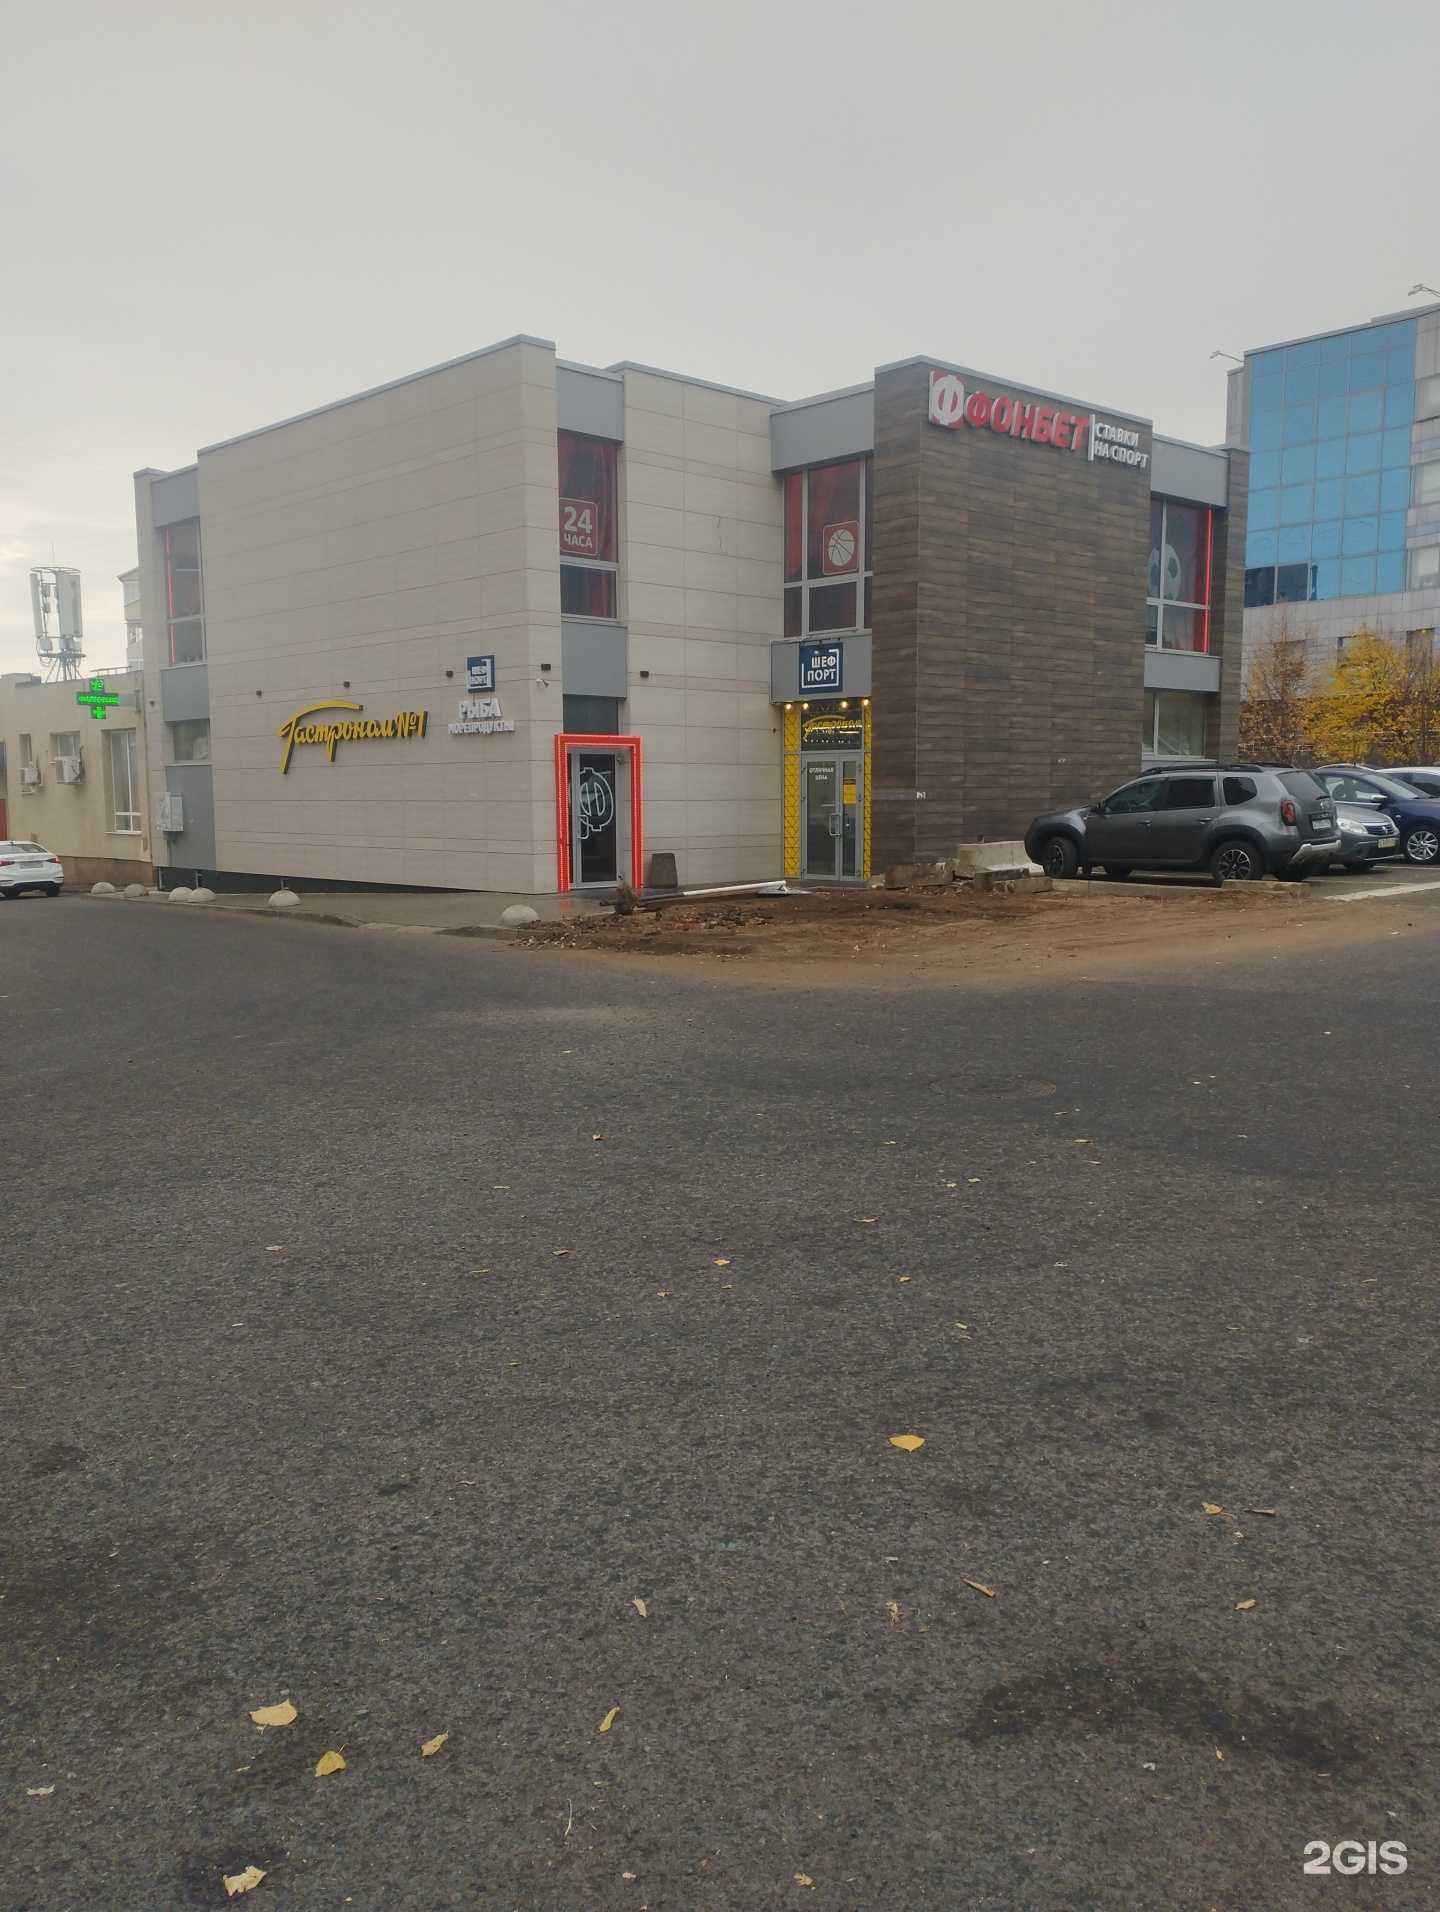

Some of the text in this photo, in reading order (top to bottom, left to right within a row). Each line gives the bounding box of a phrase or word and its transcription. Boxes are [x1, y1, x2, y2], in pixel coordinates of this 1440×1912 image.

[965, 390, 1089, 450] ФОНБЕТ
[1096, 422, 1139, 447] СТАВКИ
[1094, 440, 1149, 468] НА СПОРТ
[564, 506, 593, 534] 24
[564, 533, 593, 549] ЧАСА
[811, 655, 836, 669] ШЕФ
[807, 668, 837, 682] ПОРТ
[459, 698, 502, 719] РЫБА
[277, 700, 395, 774] Гастроном
